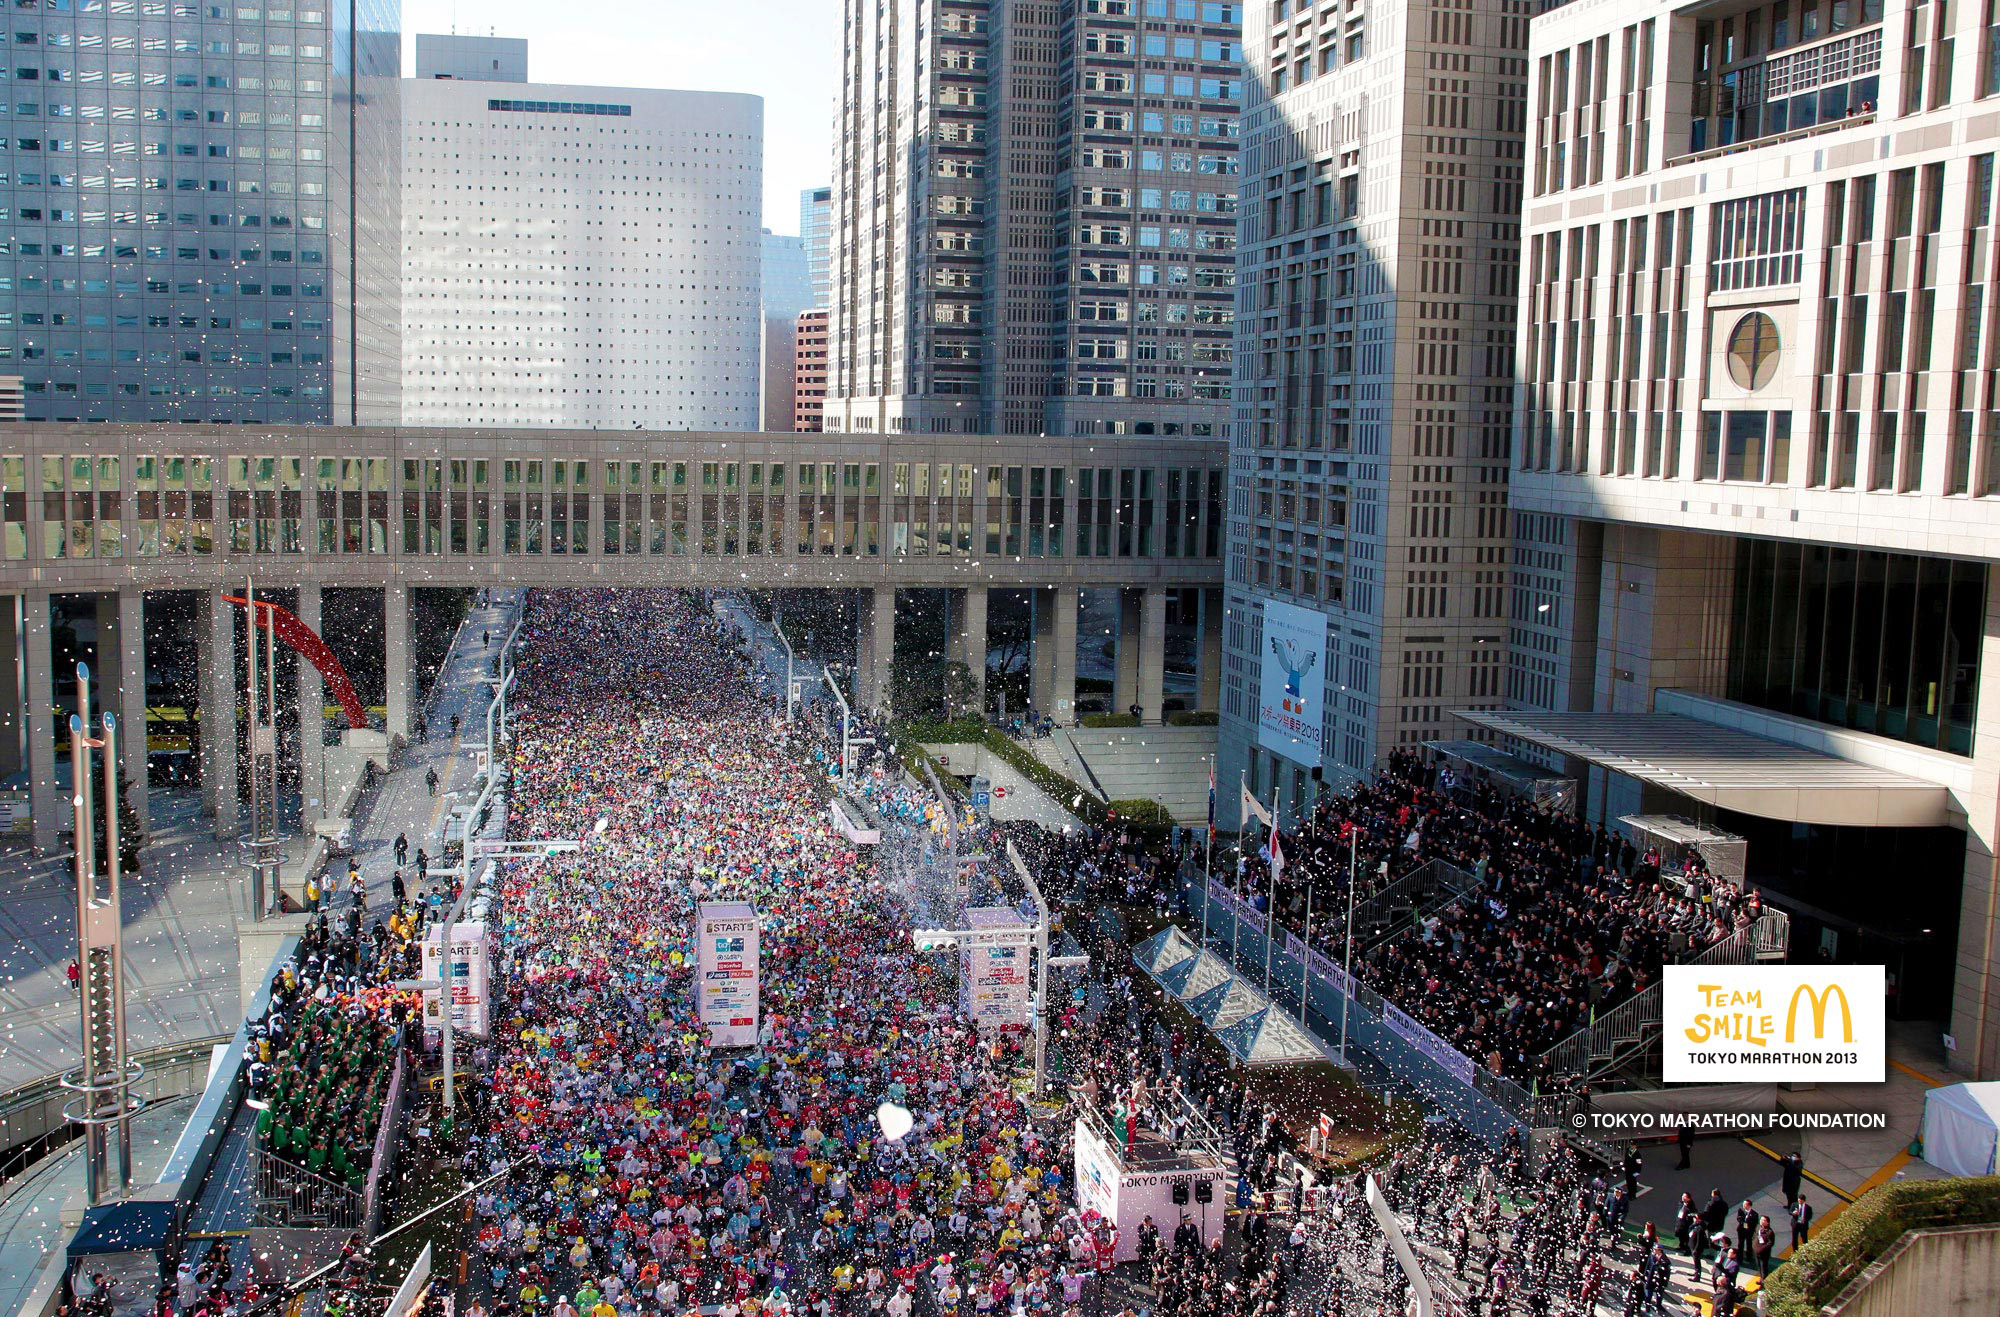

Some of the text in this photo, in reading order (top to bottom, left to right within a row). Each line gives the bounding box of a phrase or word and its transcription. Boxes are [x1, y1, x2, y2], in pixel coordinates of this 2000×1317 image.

[1229, 897, 1263, 929] MRATHON
[714, 923, 747, 933] START
[436, 946, 472, 956] SART
[1289, 938, 1311, 965] TOKYO
